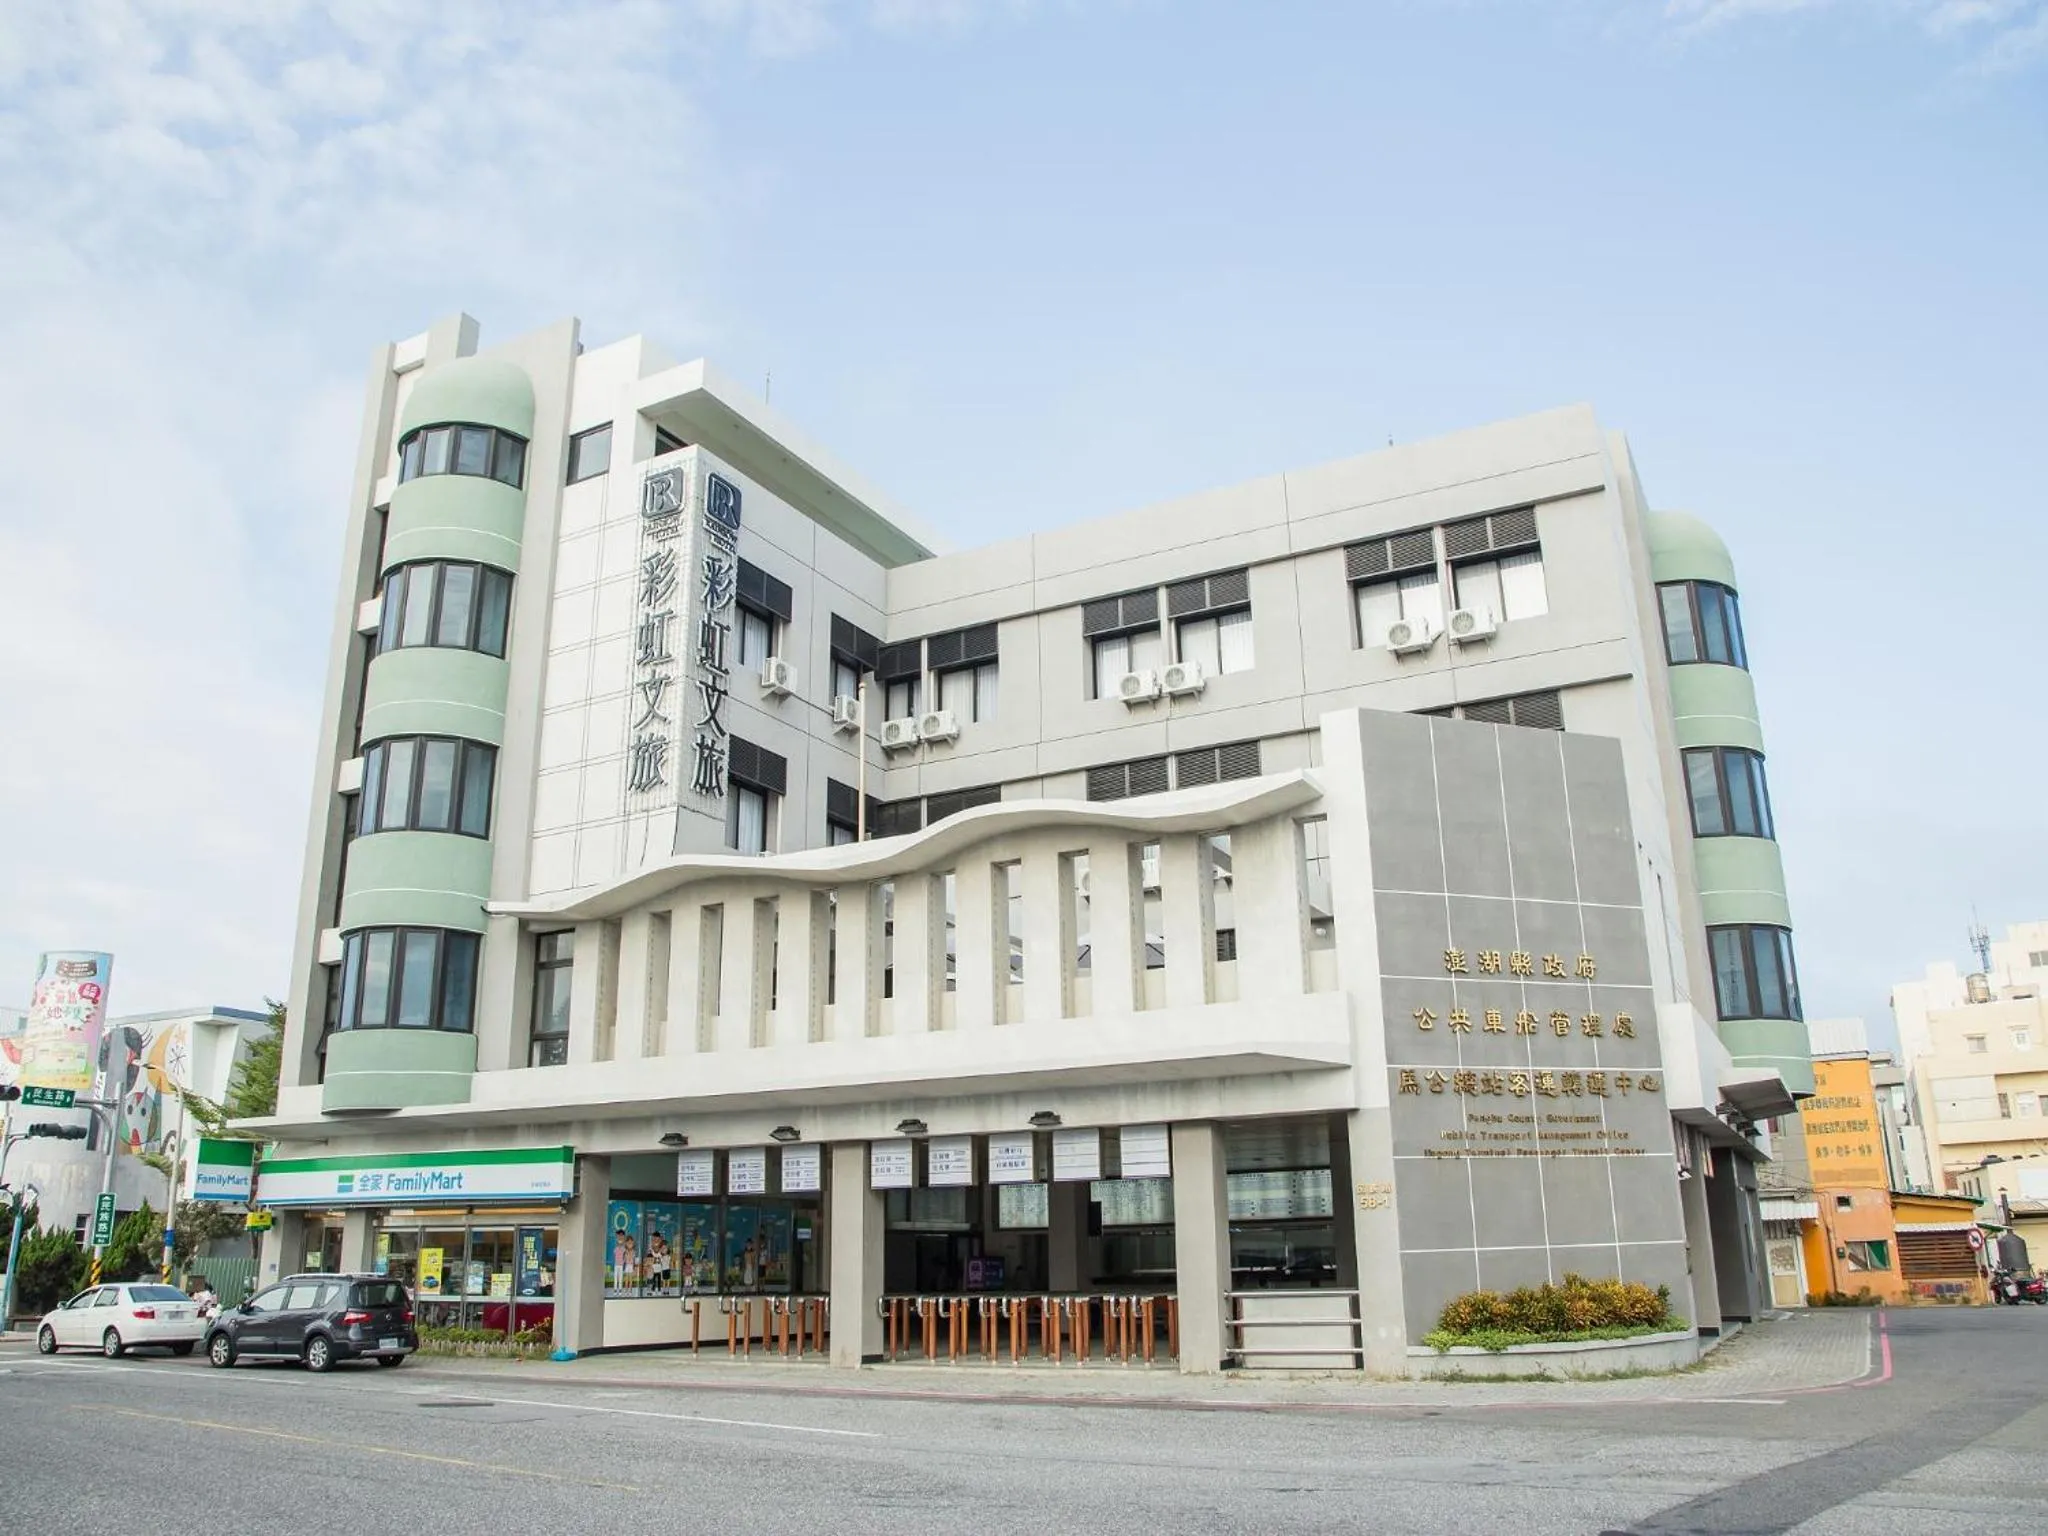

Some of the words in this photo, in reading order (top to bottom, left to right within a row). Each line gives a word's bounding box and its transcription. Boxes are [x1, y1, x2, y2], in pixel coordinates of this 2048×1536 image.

[628, 548, 677, 793] 彩虹文旅
[691, 555, 736, 797] 彩虹文旅
[1443, 948, 1597, 979] 澎湖縣政府
[1413, 1006, 1637, 1038] 公共車船管理處
[1397, 1069, 1660, 1098] 馬公總站客運轉運中心
[197, 1173, 249, 1187] FamilyMart
[358, 1174, 383, 1192] 全家
[386, 1171, 464, 1193] FamilyMart
